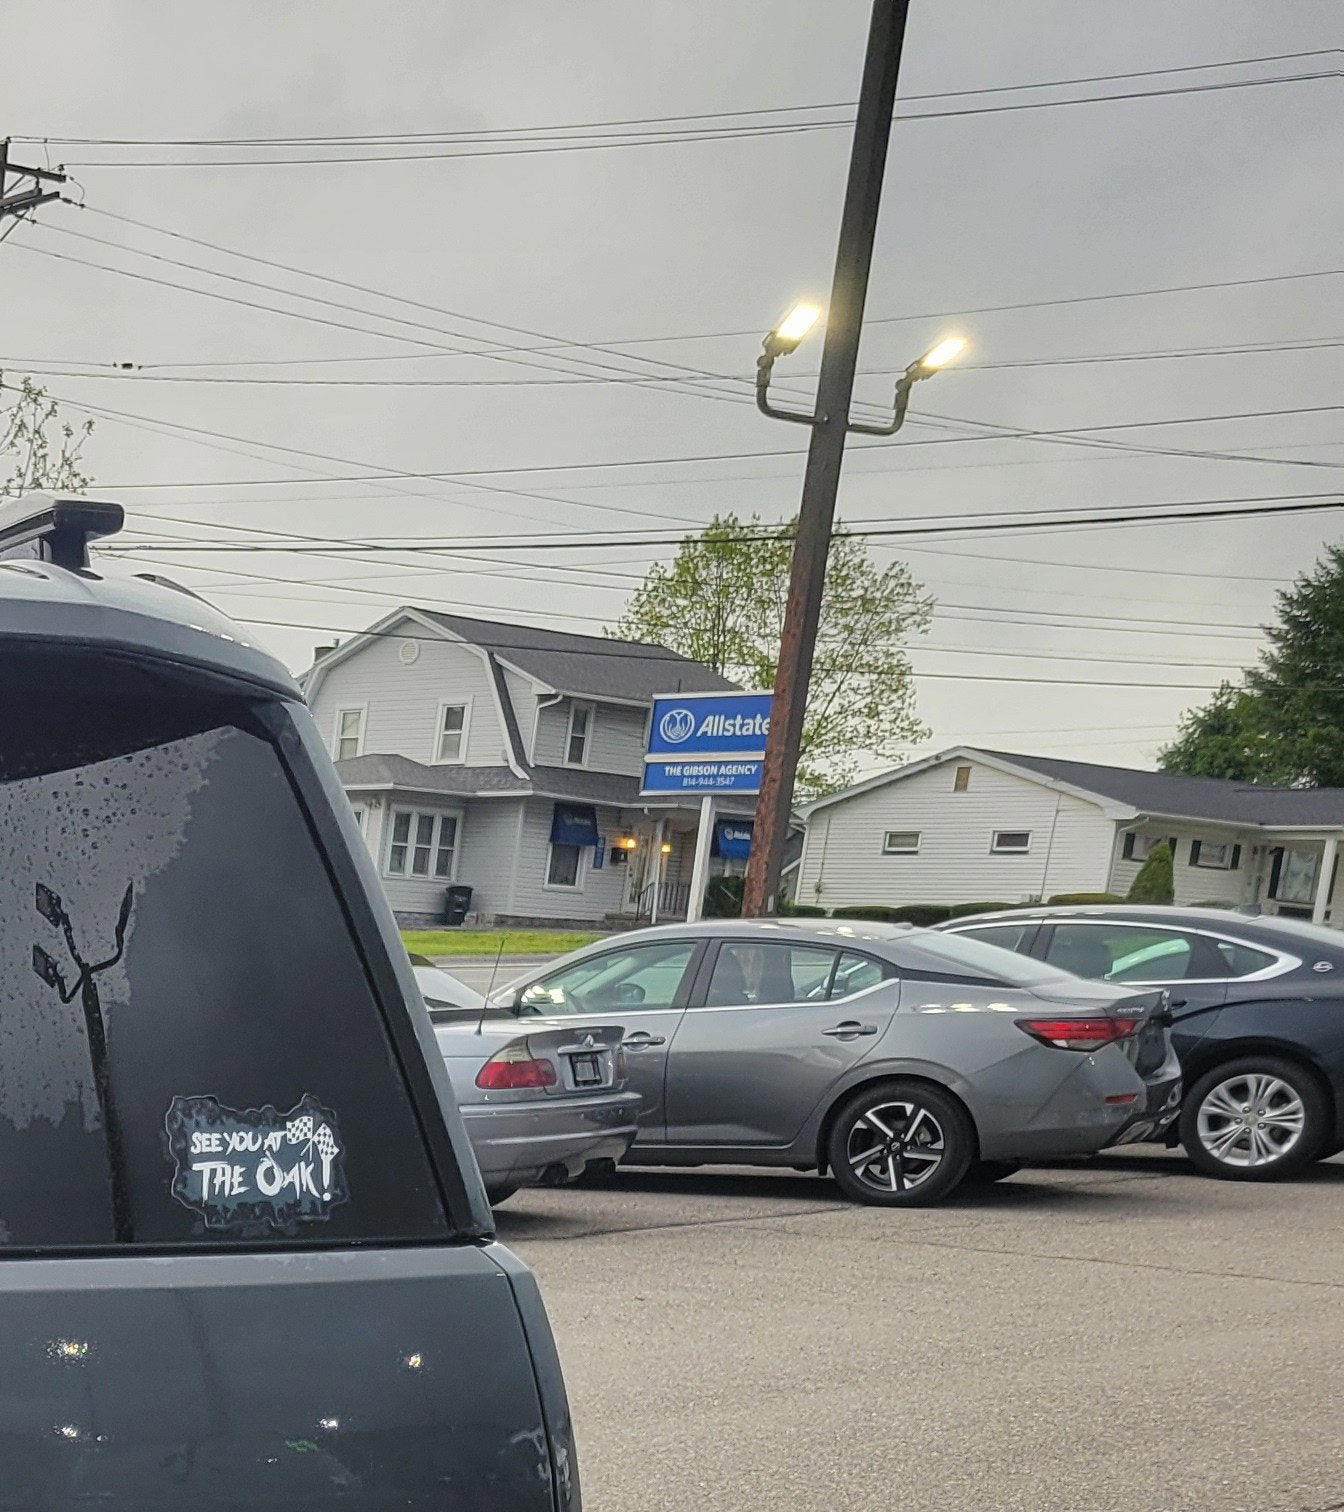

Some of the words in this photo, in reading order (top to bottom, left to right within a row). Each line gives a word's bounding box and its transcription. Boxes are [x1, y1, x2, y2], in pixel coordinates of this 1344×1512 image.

[696, 714, 770, 737] Allstate
[664, 766, 682, 776] THE
[683, 765, 717, 776] GIBSON
[720, 765, 758, 774] AGENCY
[191, 1132, 223, 1154] SEE
[223, 1131, 262, 1155] YOU
[262, 1131, 287, 1153] AT
[191, 1161, 249, 1207] THE
